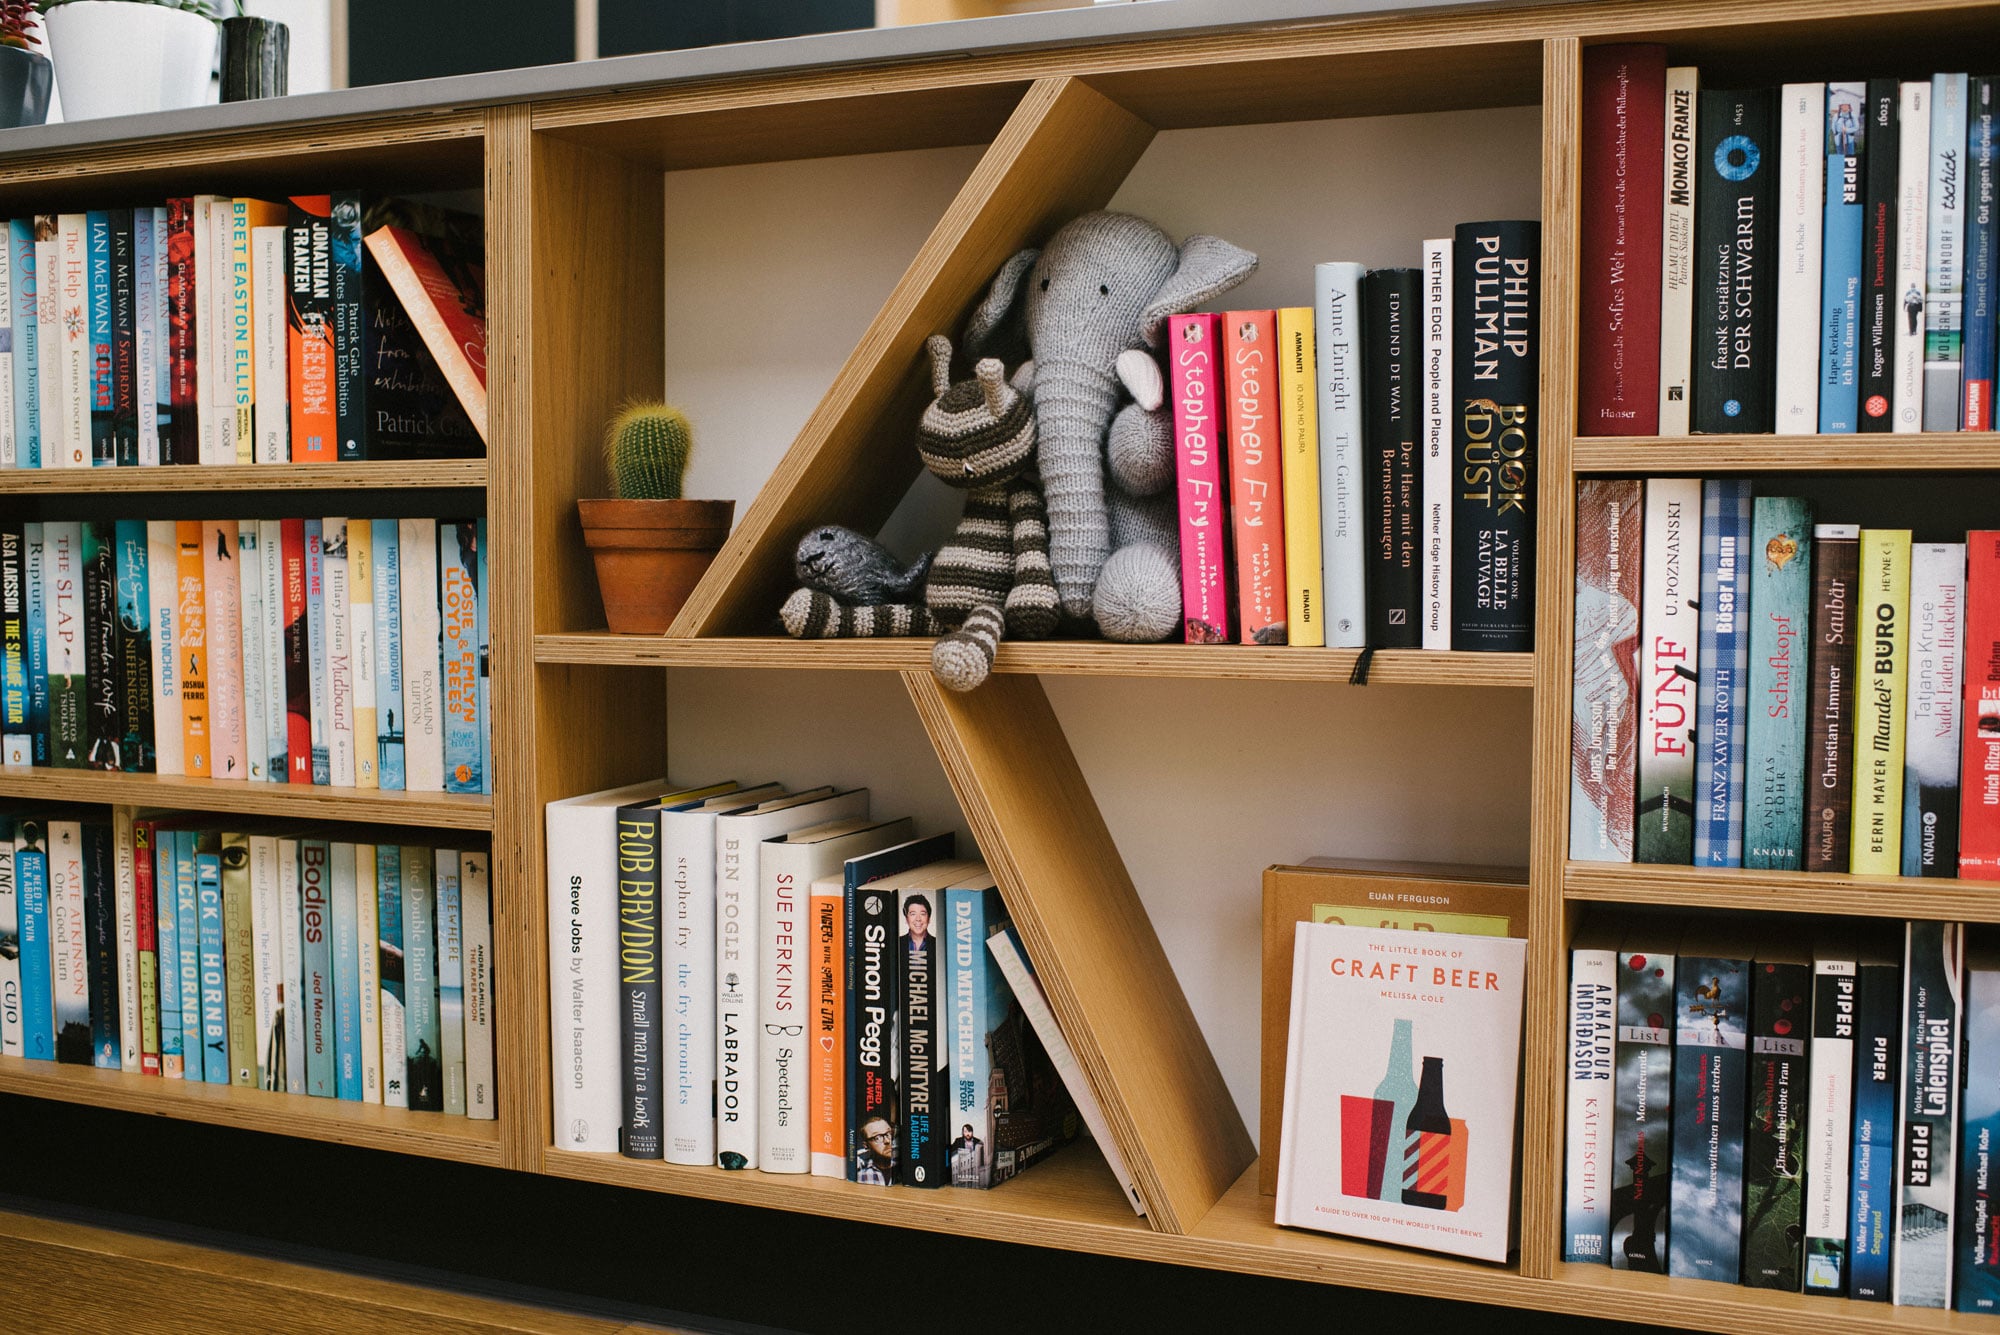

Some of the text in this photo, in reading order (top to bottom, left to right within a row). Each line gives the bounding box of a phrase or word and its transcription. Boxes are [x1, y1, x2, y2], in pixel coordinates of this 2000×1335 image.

[1670, 89, 1690, 206] MONACO FRANZE
[1734, 103, 1744, 126] 16453
[1843, 157, 1857, 202] PIPER
[1939, 148, 1957, 210] tschick
[64, 229, 81, 298] The Help
[94, 223, 106, 252] IAN
[293, 228, 310, 292] FRANZEN
[313, 222, 329, 298] JONATHAN
[233, 203, 249, 404] BRET EASTON ELLIS
[350, 303, 359, 343] Patrick
[1432, 252, 1441, 341] NETHER EDGE
[1474, 236, 1500, 380] PULLMAN
[1504, 258, 1528, 357] PHILIP
[1871, 202, 1887, 377] Roger Willemsen Deutschlandreise
[96, 344, 110, 406] SOLAR
[336, 263, 347, 417] Notes from an Exhibition
[1295, 331, 1303, 374] AMMANITI
[1329, 288, 1350, 412] Anne Enright
[1390, 293, 1400, 422] EDMUND DE WAAL
[1179, 350, 1213, 527] Stephen Fry
[1235, 349, 1267, 527] Stephen Fry
[1429, 348, 1441, 457] People and Places
[1335, 432, 1349, 538] The Gathering
[1464, 413, 1491, 507] DUST
[1492, 451, 1499, 465] OF
[1498, 404, 1528, 516] BOOK
[4, 560, 19, 613] LARSSON
[57, 535, 74, 643] THE SLAP
[1477, 531, 1491, 609] SAUVAGE
[1494, 529, 1508, 610] LA BELLE
[5, 619, 20, 639] THE
[5, 641, 21, 686] SAVAGE
[446, 567, 461, 713] LLOYD REES
[457, 571, 475, 722] JOSIE & EMLYN
[1768, 613, 1797, 718] Schafkopf
[1874, 603, 1895, 674] BÜRO
[8, 689, 23, 724] ALTAR
[1649, 636, 1687, 757] FÜNF
[1712, 536, 1735, 821] FRANZ XAVER ROTH Böser Mann
[1821, 579, 1845, 861] KNAUR Christian Limmer Saubär
[1873, 759, 1886, 803] MAYER
[1753, 847, 1794, 858] KNAUR
[1871, 812, 1884, 853] BERNI
[55, 873, 68, 980] One Good Turn
[68, 860, 84, 996] KATE ATKINSON
[725, 839, 740, 962] BEN FOGLE
[1369, 892, 1450, 904] EUAN FERGUSON
[201, 864, 224, 1054] NICK HORNBY
[304, 847, 325, 1054] Bodies Jed Mercurio
[619, 820, 655, 1128] ROB BRYDON small man in a book
[675, 856, 692, 1105] stephen fry the fry chronicles
[776, 873, 793, 1011] SUE PERKINS
[1331, 958, 1499, 991] CRAFT BEER
[1369, 944, 1385, 952] THE
[1389, 947, 1418, 955] LITTLE
[1422, 949, 1447, 957] BOOK
[5, 980, 18, 1024] CUJO
[570, 875, 583, 1090] Steve Jobs by Walter Isaacson
[860, 925, 886, 1067] Simon Pegg
[908, 950, 927, 1025] MICHAEL
[956, 901, 974, 1078] DAVID MITCHELL
[1381, 992, 1444, 1003] MELISSA COLE
[1836, 981, 1853, 1036] PIPER
[724, 1013, 738, 1123] LABRADOR
[1594, 984, 1612, 1081] ARNALDUR
[1630, 1030, 1659, 1042] List
[1924, 1018, 1952, 1115] Laienspiel
[775, 1048, 792, 1127] Spectacles
[866, 1071, 873, 1086] DO
[874, 1077, 882, 1104] NERD
[959, 1080, 968, 1112] STORY
[967, 1080, 975, 1108] BACK
[1636, 1048, 1648, 1122] Mordsfreunde
[910, 1115, 920, 1159] LAUGHING
[920, 1114, 929, 1143] LIFE &
[1912, 1125, 1928, 1183] PIPER
[1321, 1207, 1340, 1215] GUIDE
[1437, 1226, 1459, 1234] FINEST
[1461, 1230, 1483, 1238] BREWS
